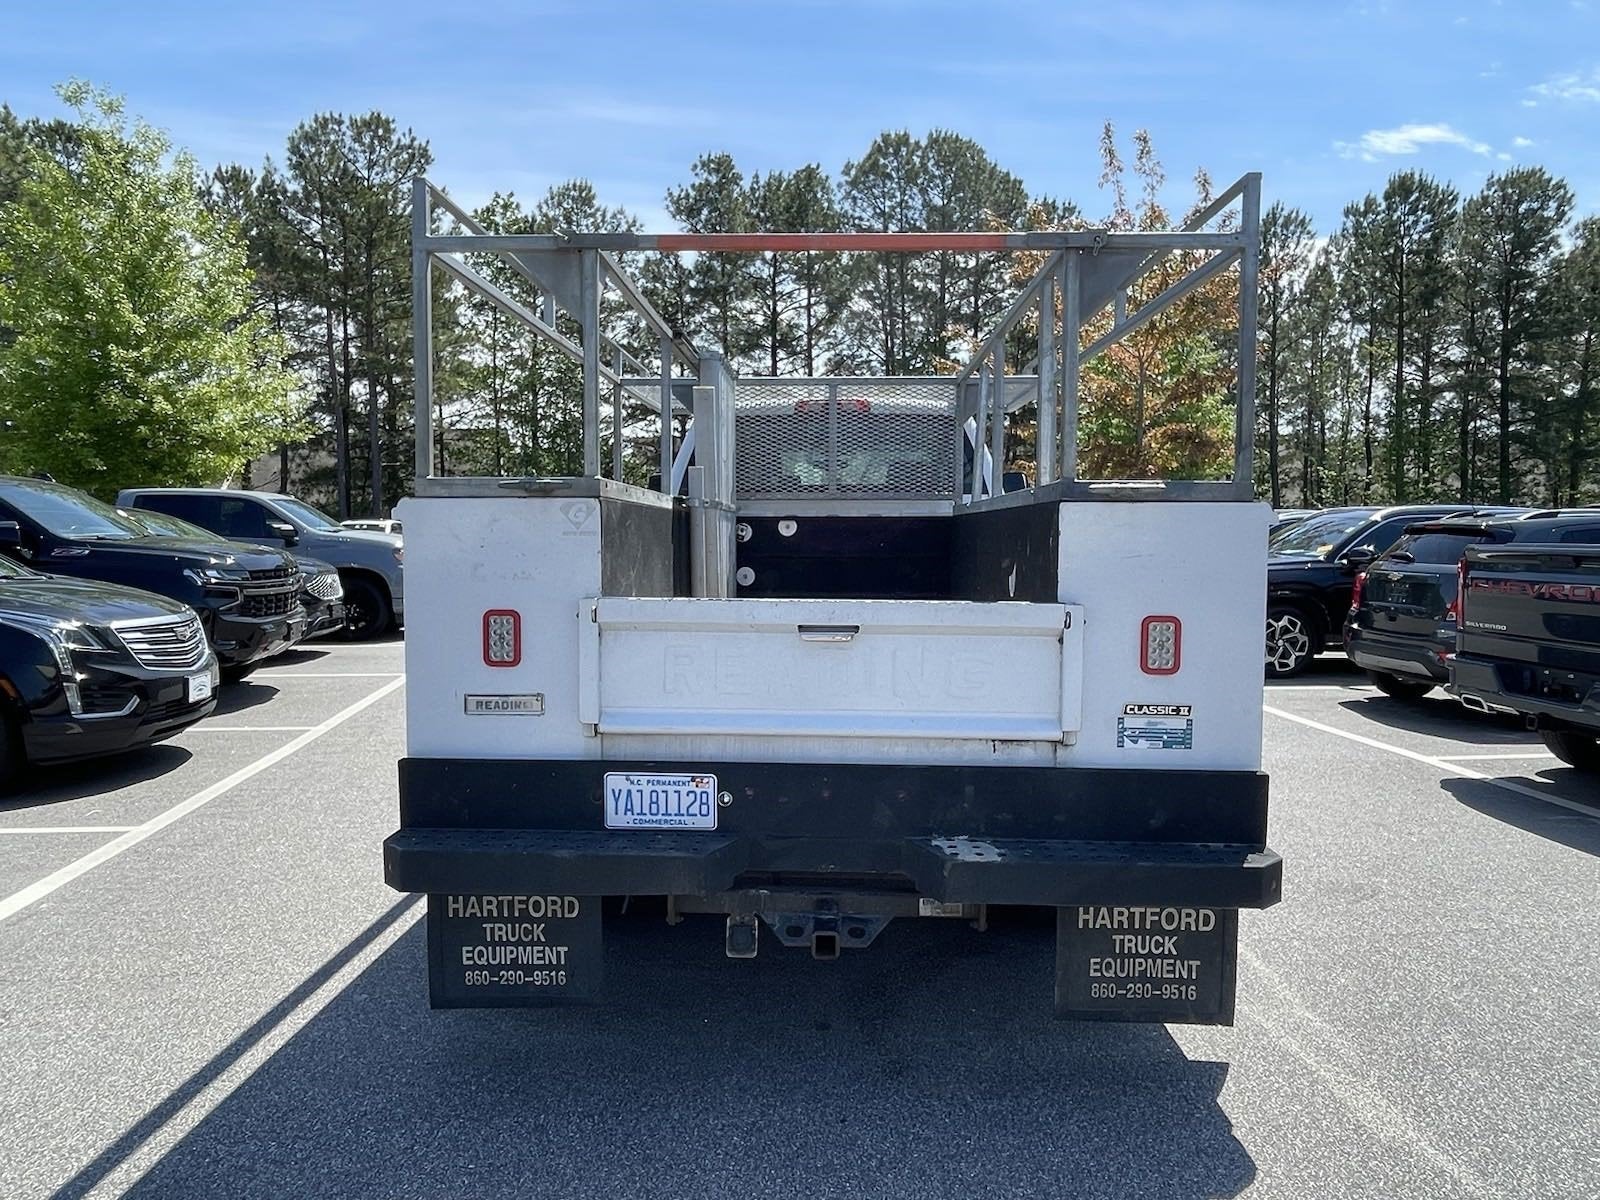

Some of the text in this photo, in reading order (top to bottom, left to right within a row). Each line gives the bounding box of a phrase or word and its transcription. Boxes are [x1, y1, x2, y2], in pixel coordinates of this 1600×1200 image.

[1126, 704, 1177, 715] CLASSIC
[646, 779, 691, 787] PERMANENT
[611, 788, 710, 817] YA181128
[632, 818, 688, 826] COMMERCIAL
[447, 895, 580, 919] HARTFORD
[1078, 906, 1216, 932] HARTFORD
[482, 923, 546, 942] TRUCK
[1112, 934, 1178, 956] TRUCK
[461, 946, 569, 966] EQUIPMENT
[464, 970, 567, 986] 860-290-9516
[1089, 958, 1201, 980] EQUIPMENT
[1090, 982, 1198, 1001] 860-290-9516
